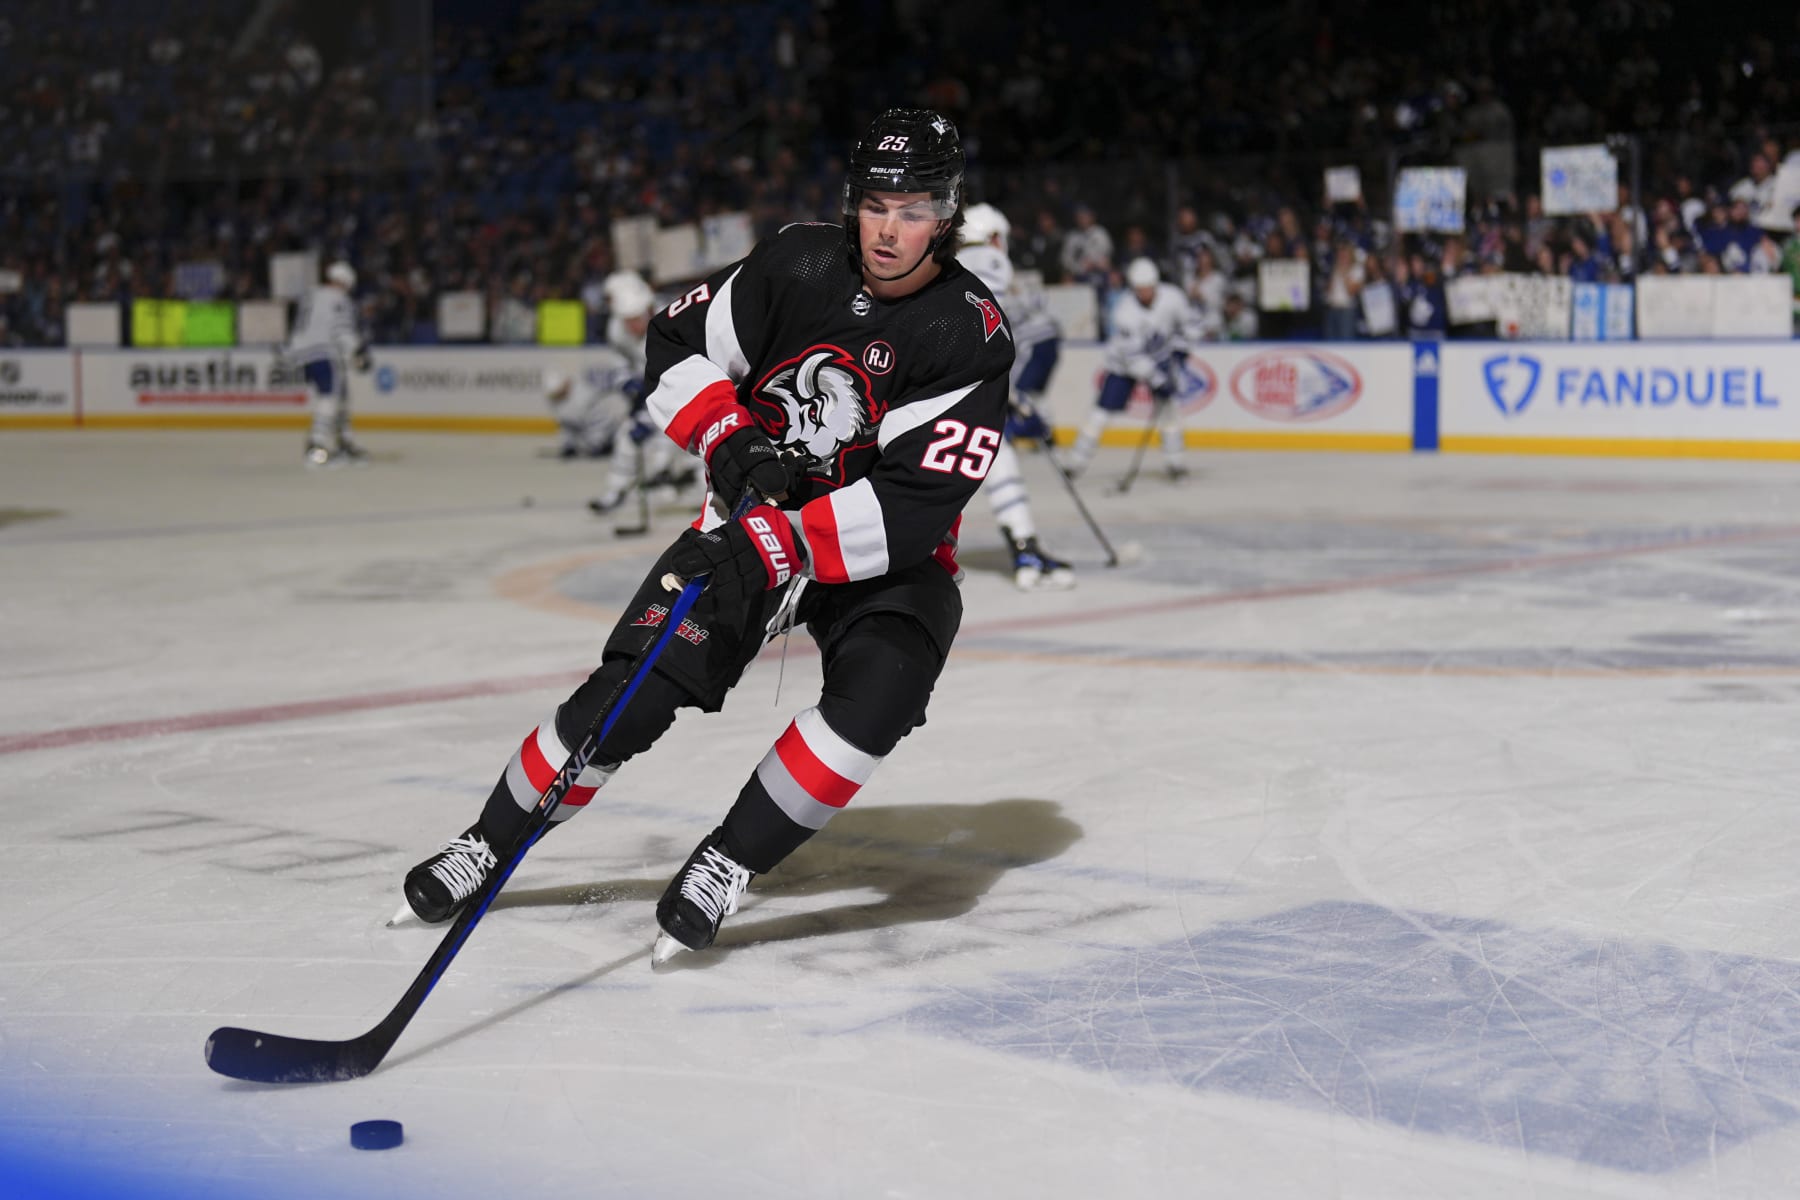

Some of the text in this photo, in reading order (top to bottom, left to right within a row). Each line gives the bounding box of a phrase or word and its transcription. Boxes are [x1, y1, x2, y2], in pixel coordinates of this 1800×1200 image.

[877, 135, 909, 151] 25
[869, 166, 905, 174] BAUER
[129, 356, 257, 389] austin
[867, 347, 890, 369] RJ
[1556, 368, 1779, 406] FANDUEL
[698, 412, 740, 459] UER
[919, 418, 1002, 481] 25
[747, 516, 791, 588] BAUE
[538, 734, 598, 817] SYNC
